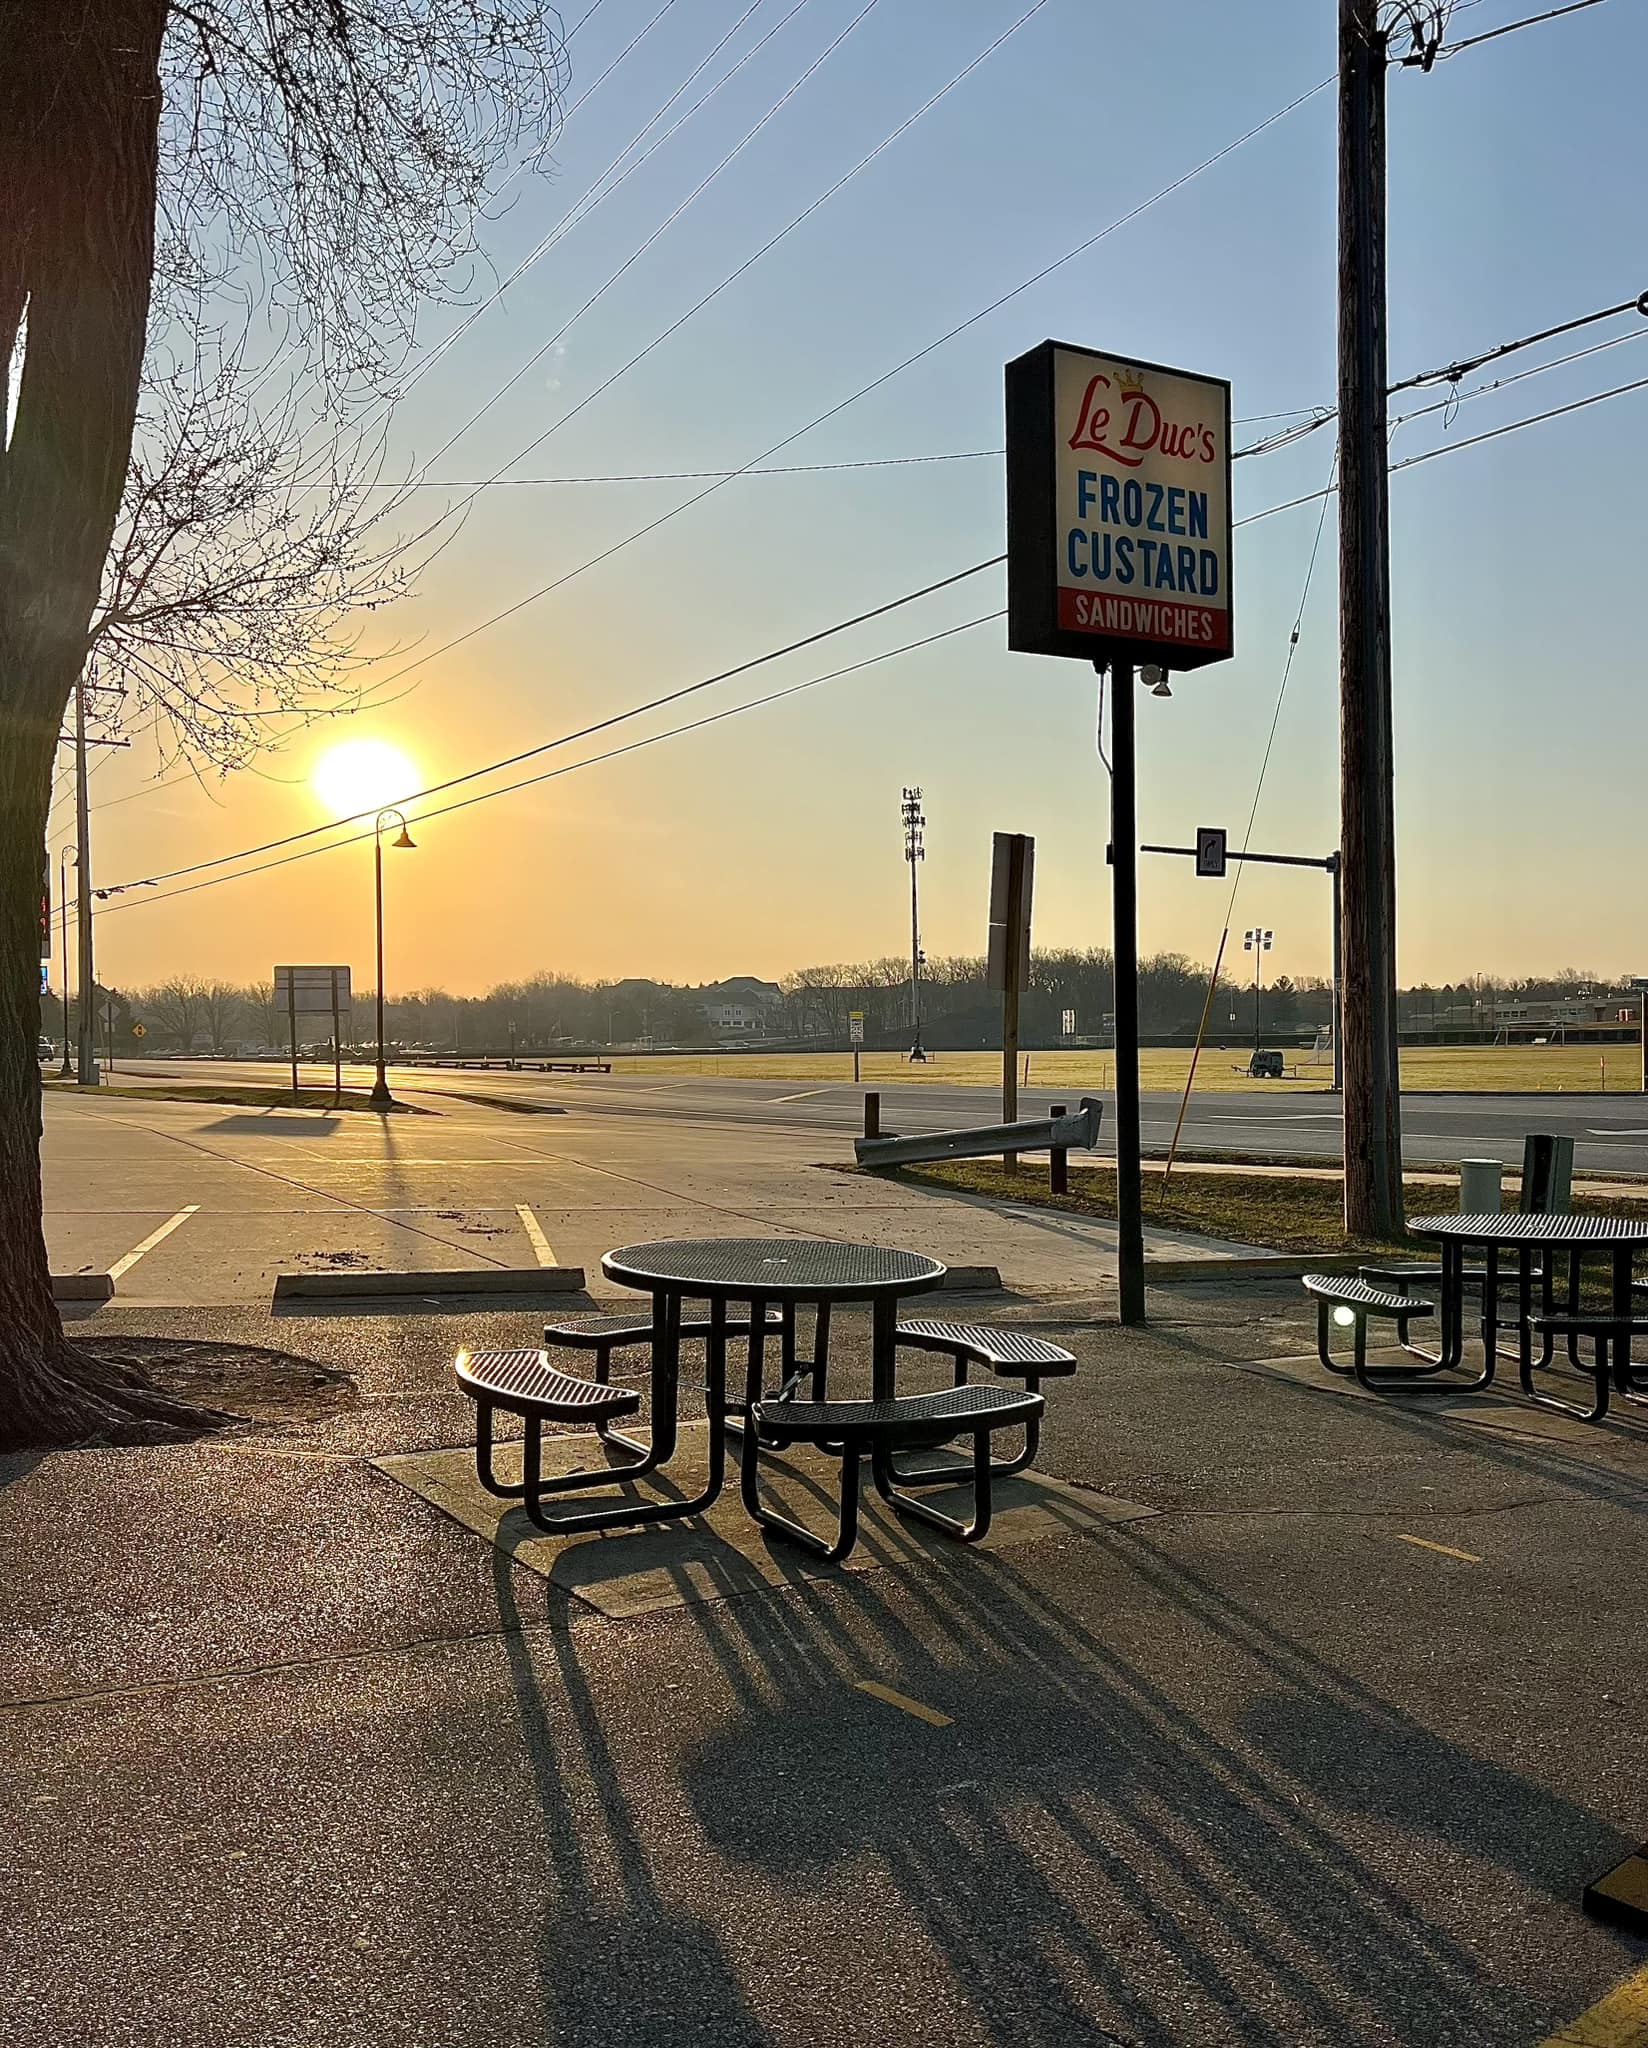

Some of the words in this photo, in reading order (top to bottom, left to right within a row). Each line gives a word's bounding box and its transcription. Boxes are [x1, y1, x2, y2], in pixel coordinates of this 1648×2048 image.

[1068, 374, 1144, 467] Le
[1119, 391, 1215, 463] Duc's
[1077, 469, 1208, 539] FROZEN
[1067, 528, 1219, 596] CUSTARD
[1076, 594, 1213, 641] SANDWICHES
